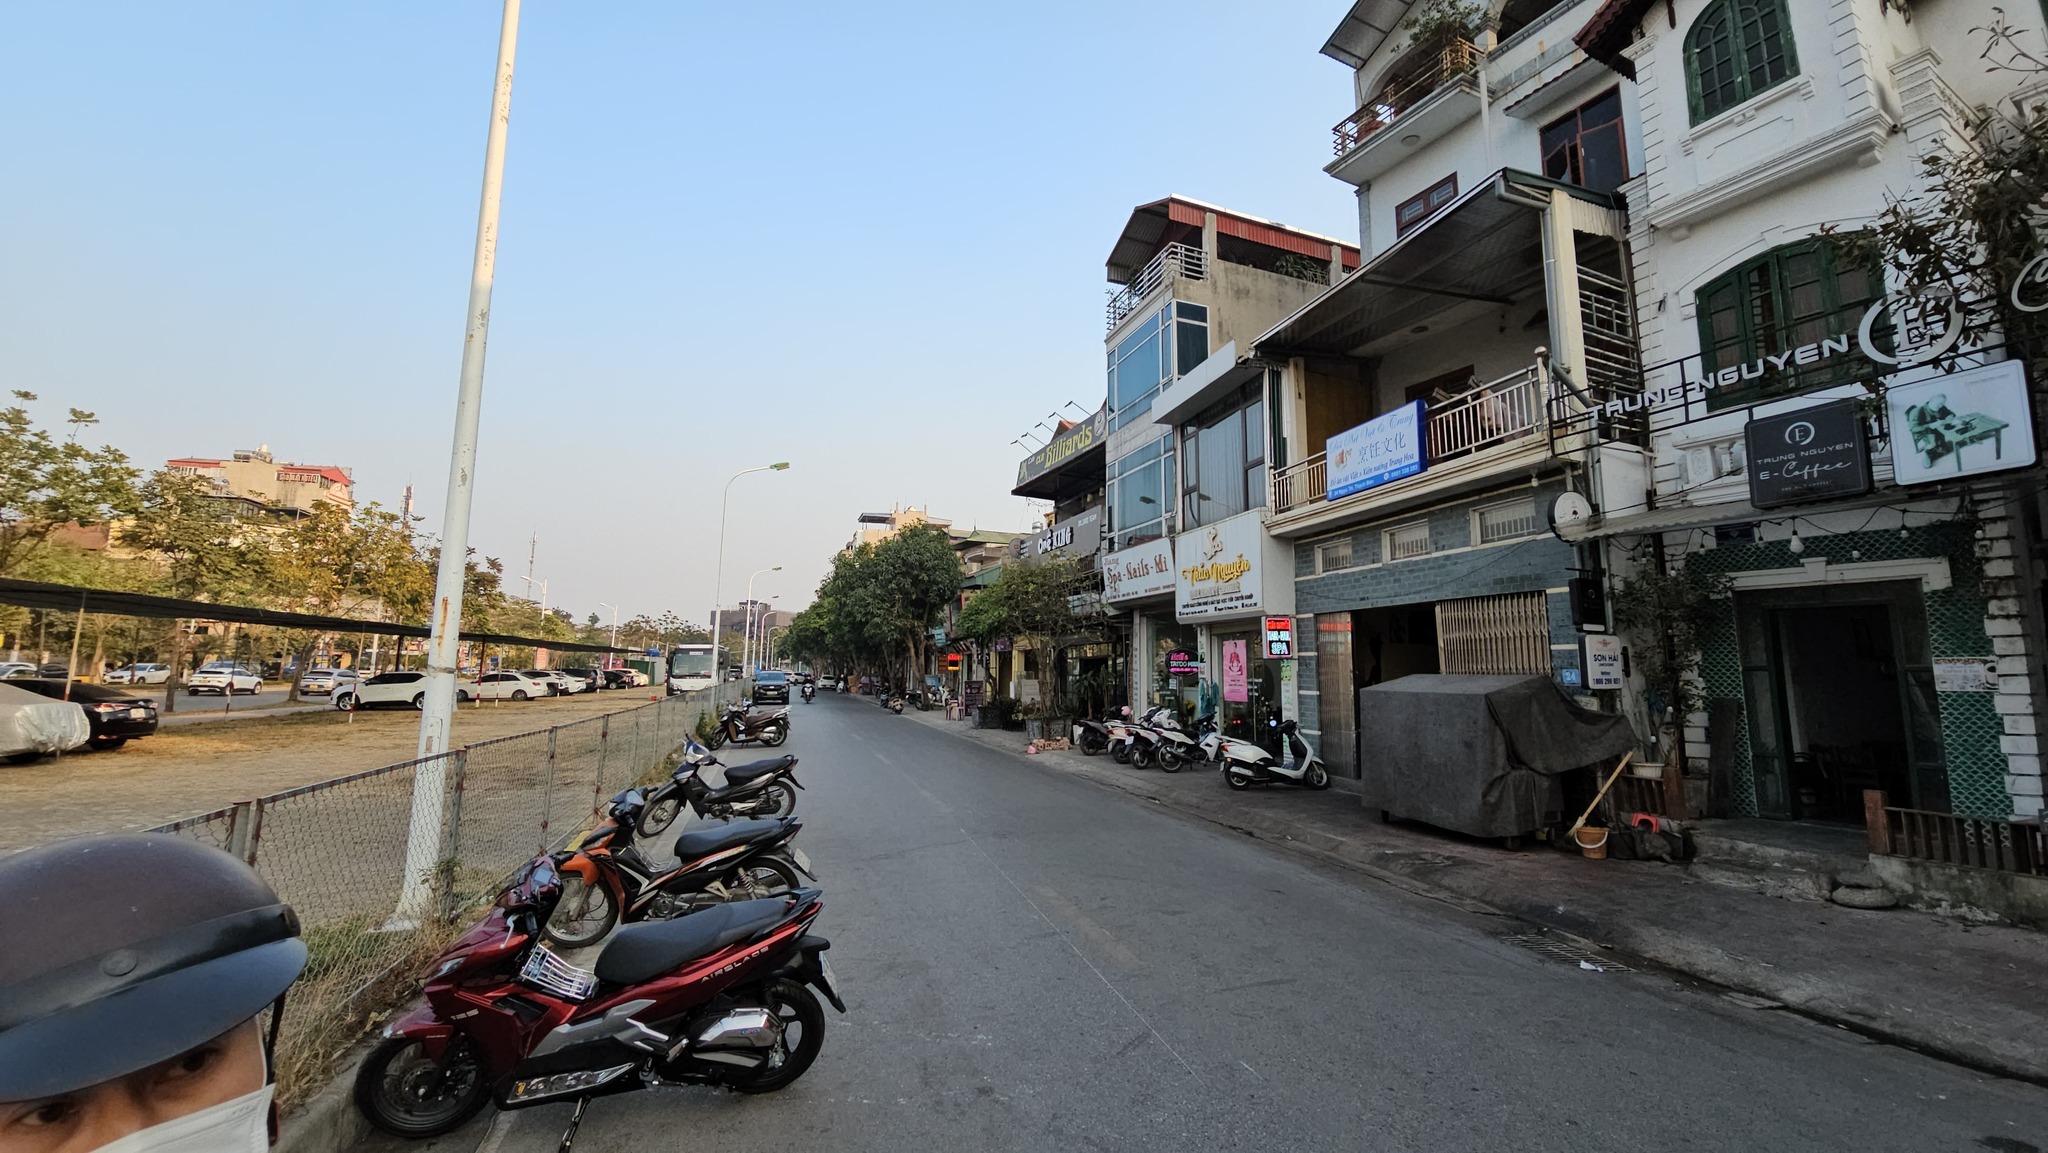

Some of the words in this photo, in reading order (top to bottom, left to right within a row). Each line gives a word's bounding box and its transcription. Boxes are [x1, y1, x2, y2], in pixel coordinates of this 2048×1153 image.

[1587, 384, 1684, 420] TRUNG
[1693, 334, 1850, 393] NGUYEN
[1044, 424, 1092, 469] Billiards
[1756, 452, 1796, 466] TRUNG
[1800, 441, 1854, 457] NGUYEN
[1053, 526, 1072, 550] KING
[1107, 567, 1122, 593] Spa
[1126, 557, 1150, 581] Nails
[1154, 553, 1169, 574] Mi
[1271, 642, 1289, 655] SPA
